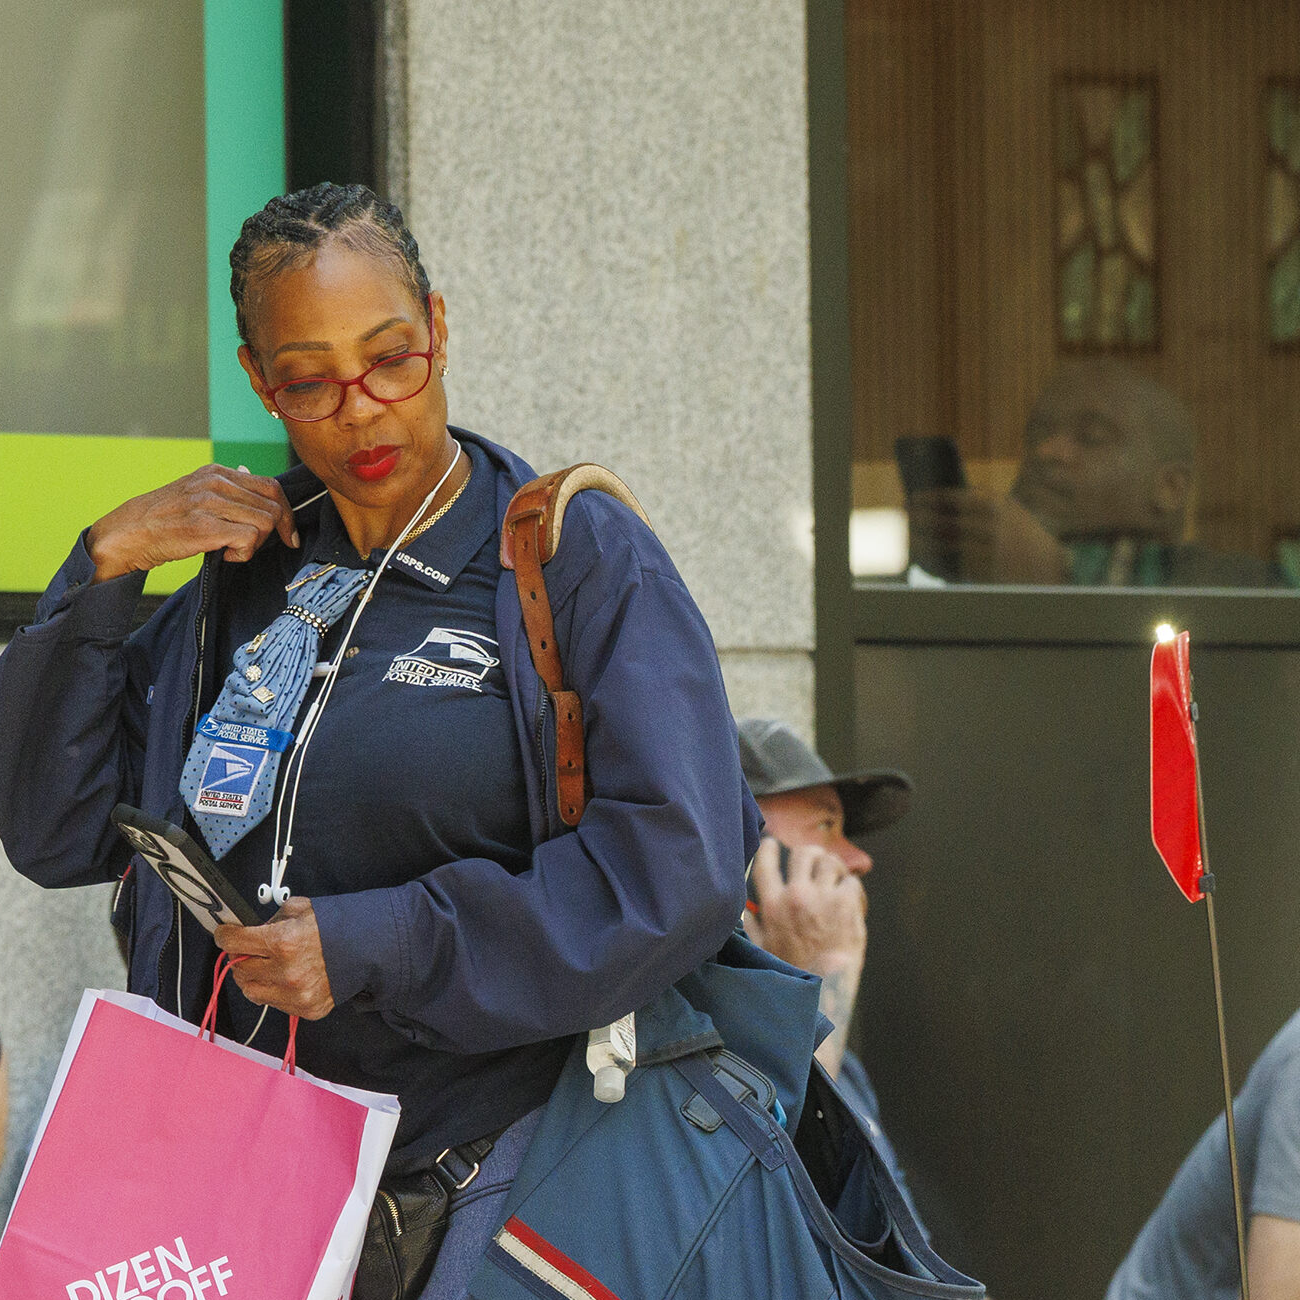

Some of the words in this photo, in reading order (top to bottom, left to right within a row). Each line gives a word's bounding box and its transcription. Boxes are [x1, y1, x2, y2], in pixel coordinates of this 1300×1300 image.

[396, 551, 450, 585] USPS.COM
[382, 670, 427, 687] POSTAL
[389, 660, 435, 677] UNITED
[434, 669, 481, 687] STATES
[217, 729, 239, 741] POSTAL
[222, 723, 242, 734] UNITED
[242, 725, 268, 737] STATES
[200, 790, 221, 798] UNITED
[221, 792, 243, 801] STATES
[199, 798, 218, 807] POSTAL
[218, 801, 244, 811] SERVICE
